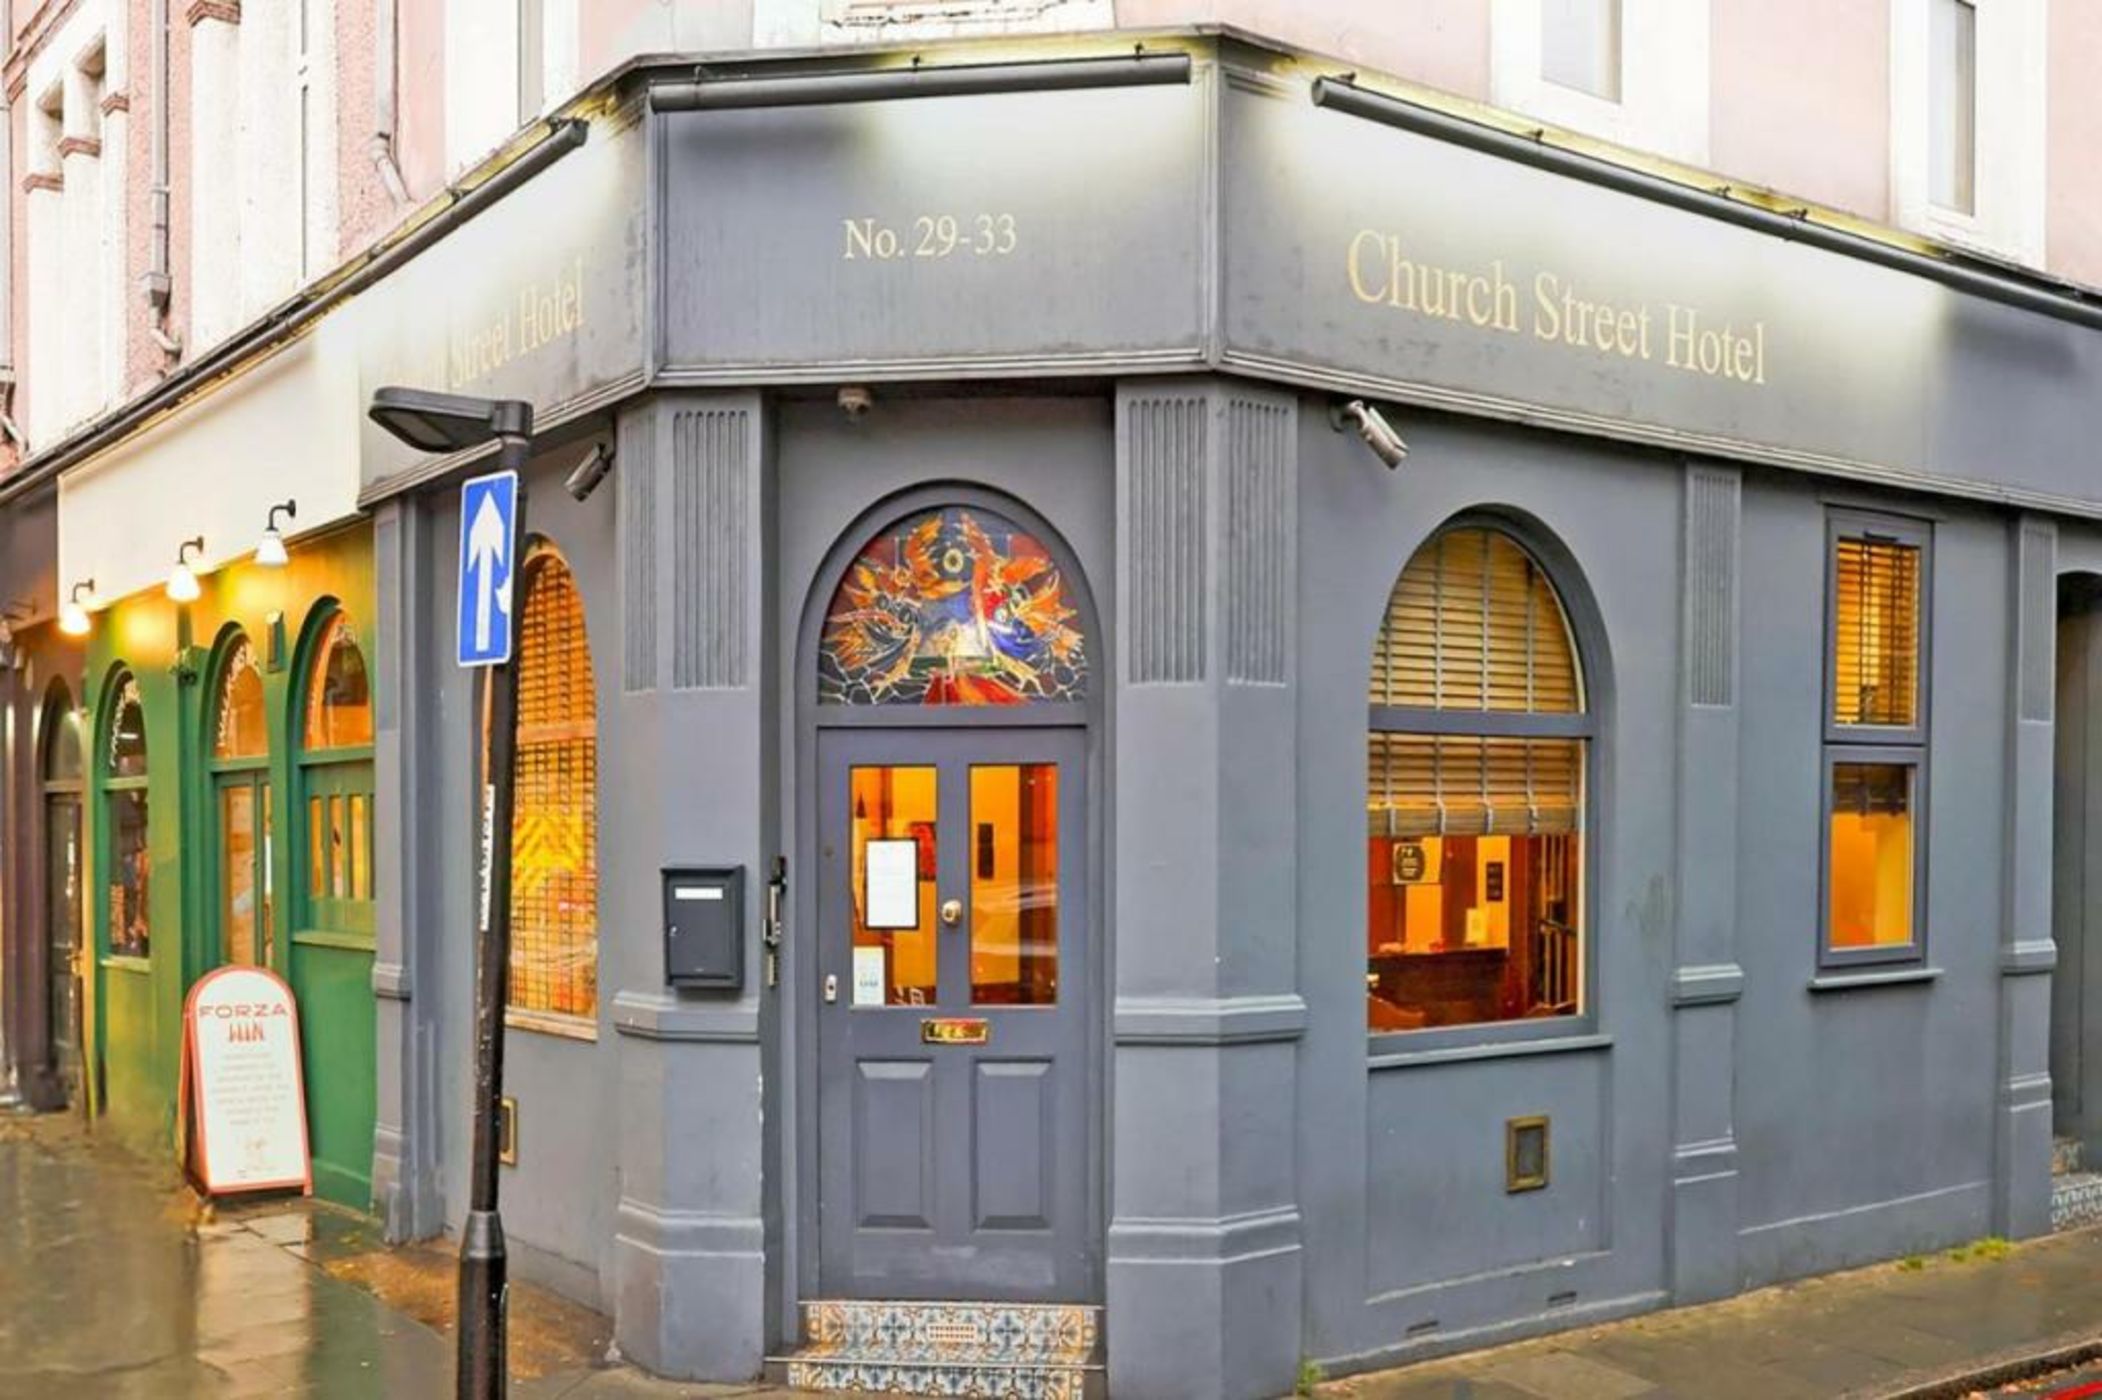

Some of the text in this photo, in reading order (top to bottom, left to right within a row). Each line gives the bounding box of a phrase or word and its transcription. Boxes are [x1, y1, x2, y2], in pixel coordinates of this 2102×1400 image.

[841, 213, 1017, 260] No. 29-33
[520, 256, 585, 354] Hotel
[1346, 229, 1766, 384] Church Street Hotel
[199, 1003, 288, 1019] FORZA
